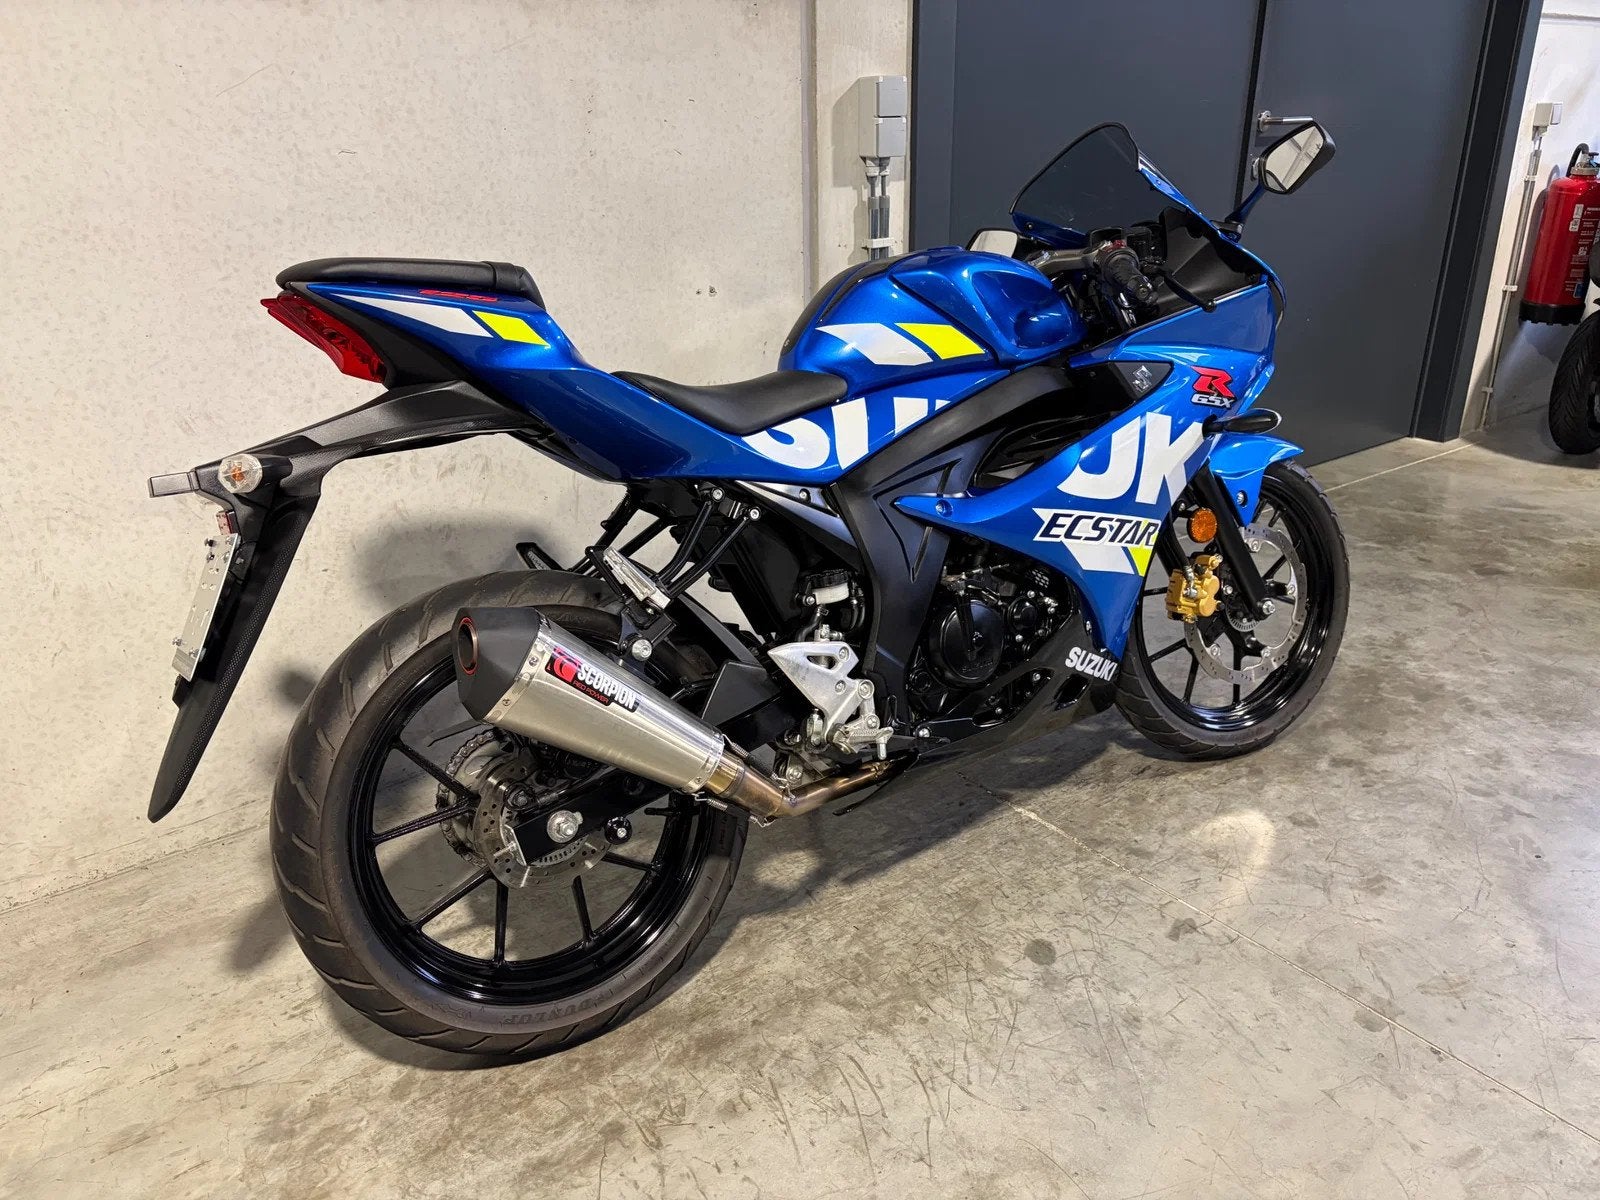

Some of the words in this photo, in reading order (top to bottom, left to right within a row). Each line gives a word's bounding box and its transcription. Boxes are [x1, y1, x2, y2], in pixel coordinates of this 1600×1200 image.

[1191, 393, 1235, 408] GSX
[1039, 512, 1159, 547] ECSTAR
[1065, 646, 1118, 682] SUZUKI
[577, 663, 637, 709] SCORPION
[586, 687, 609, 703] POWER
